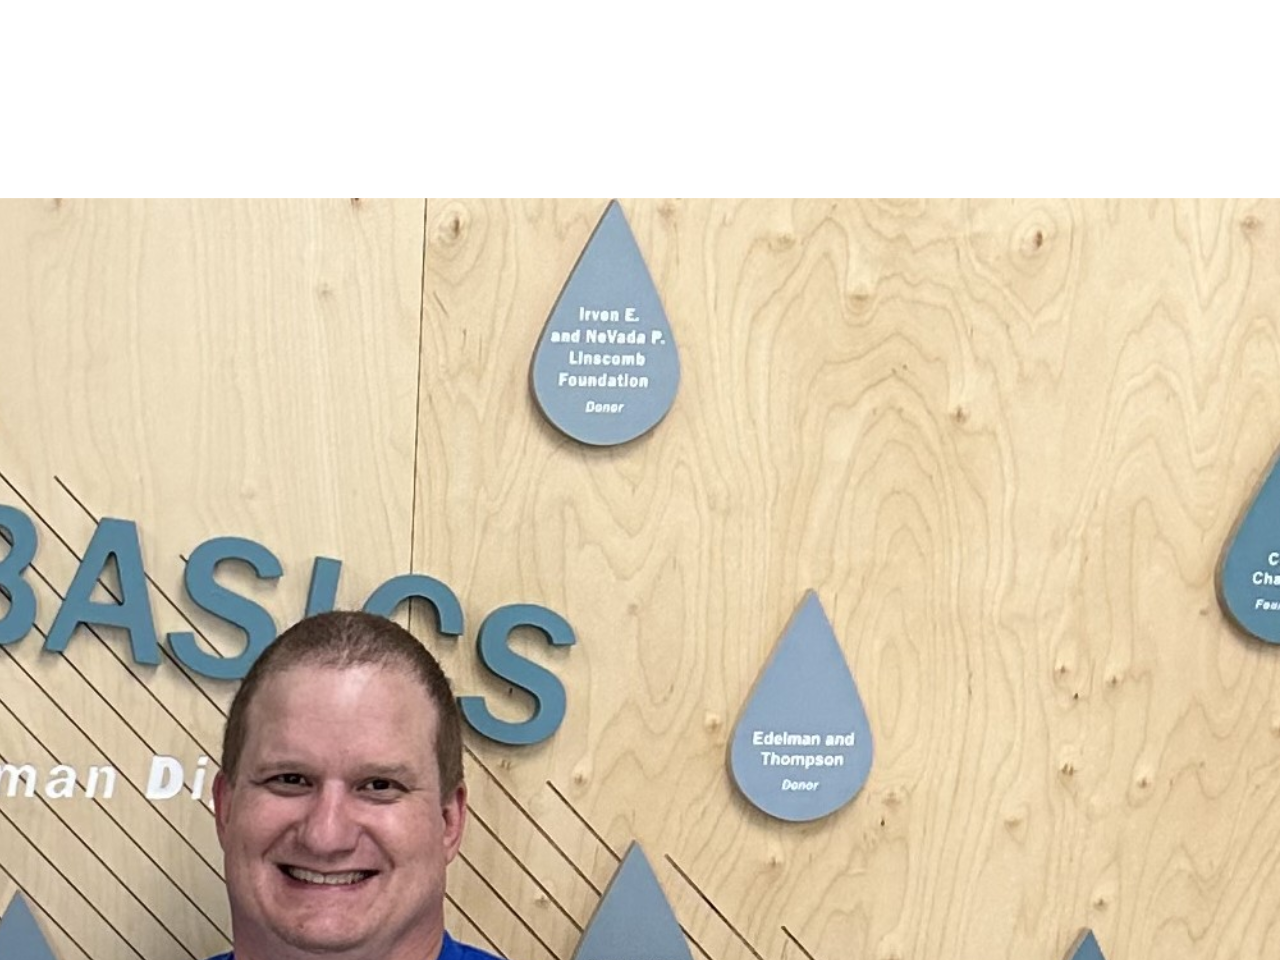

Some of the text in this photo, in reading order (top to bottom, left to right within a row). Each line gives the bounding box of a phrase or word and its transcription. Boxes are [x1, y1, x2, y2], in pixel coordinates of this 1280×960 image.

[579, 306, 640, 322] Irven E.
[550, 329, 666, 345] and NeVada P.
[569, 350, 646, 366] Linscomb
[558, 372, 649, 388] Foundation
[585, 400, 625, 413] Donor
[1252, 571, 1280, 586] Cha
[752, 731, 855, 747] Edelman and
[760, 751, 845, 770] Thompson
[781, 778, 820, 792] Donor
